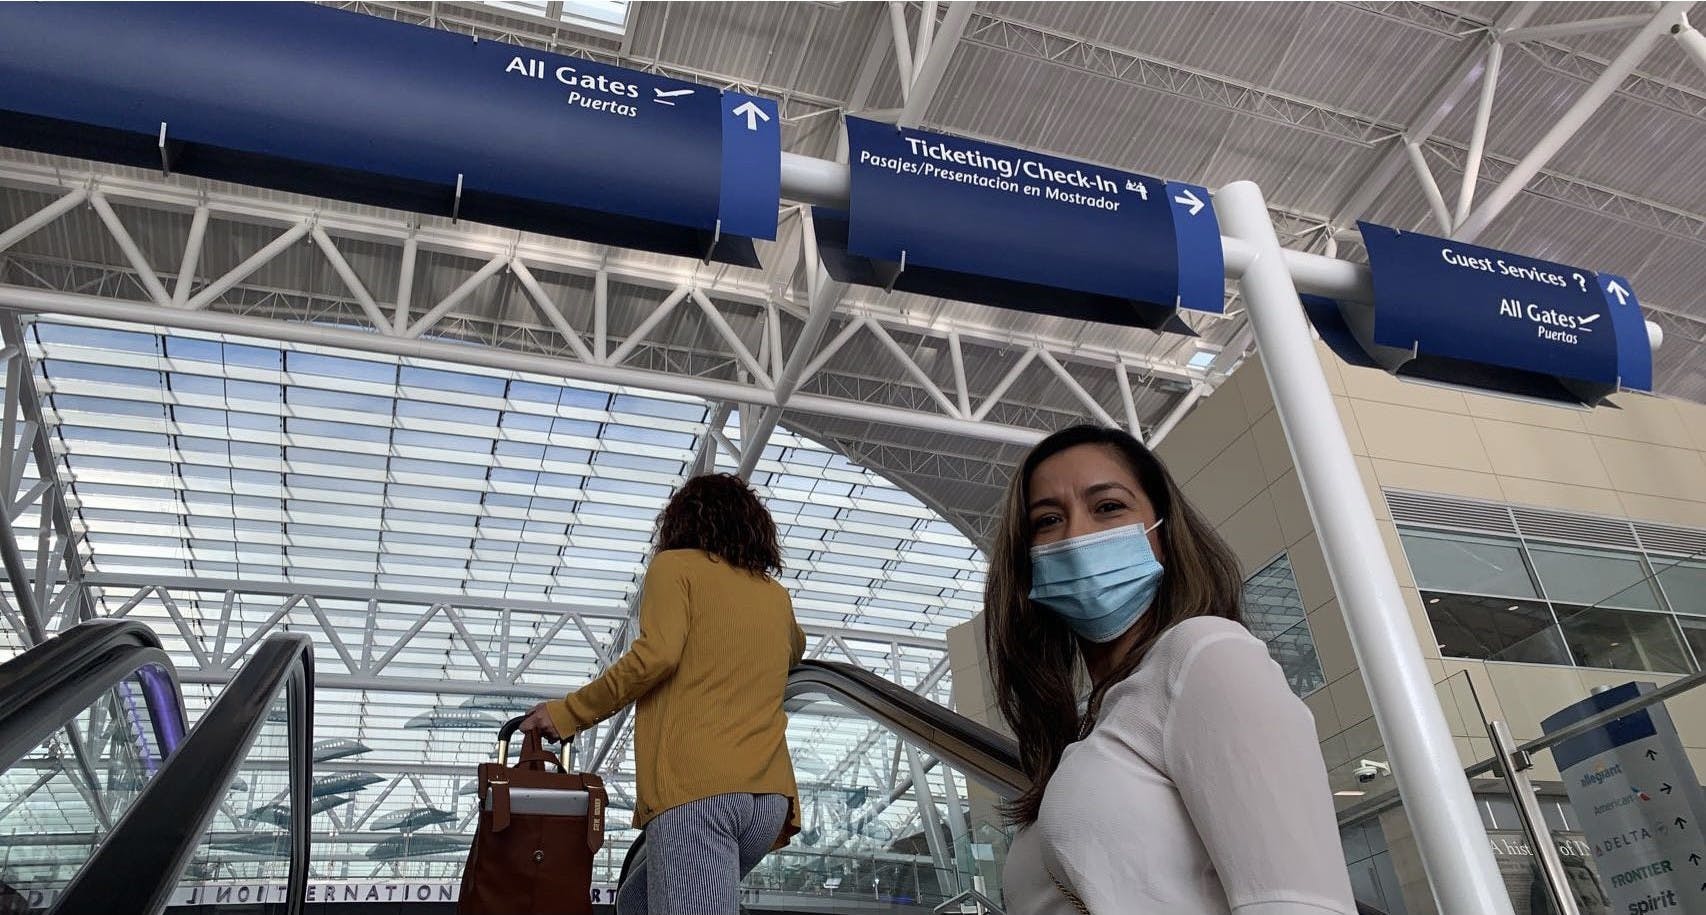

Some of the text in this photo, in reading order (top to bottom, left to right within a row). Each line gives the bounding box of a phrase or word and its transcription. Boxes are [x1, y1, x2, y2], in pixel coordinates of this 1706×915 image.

[505, 56, 640, 98] All Gates
[567, 91, 638, 118] Puertas
[905, 136, 1119, 194] Ticketing/Check-In
[860, 150, 1121, 212] Pasajes/Presentacion en Mostrador
[1441, 248, 1496, 273] Guest
[1497, 259, 1567, 288] Services
[1499, 298, 1577, 329] All Gates
[1537, 325, 1578, 345] Puertas
[1580, 763, 1624, 788] allegiant
[1593, 794, 1635, 817] American
[1501, 838, 1535, 856] hist
[1559, 839, 1576, 856] of
[1603, 827, 1652, 852] DELTA
[1610, 859, 1674, 889] FRONTIER
[306, 884, 454, 902] ERNATION
[1628, 889, 1677, 915] spirit
